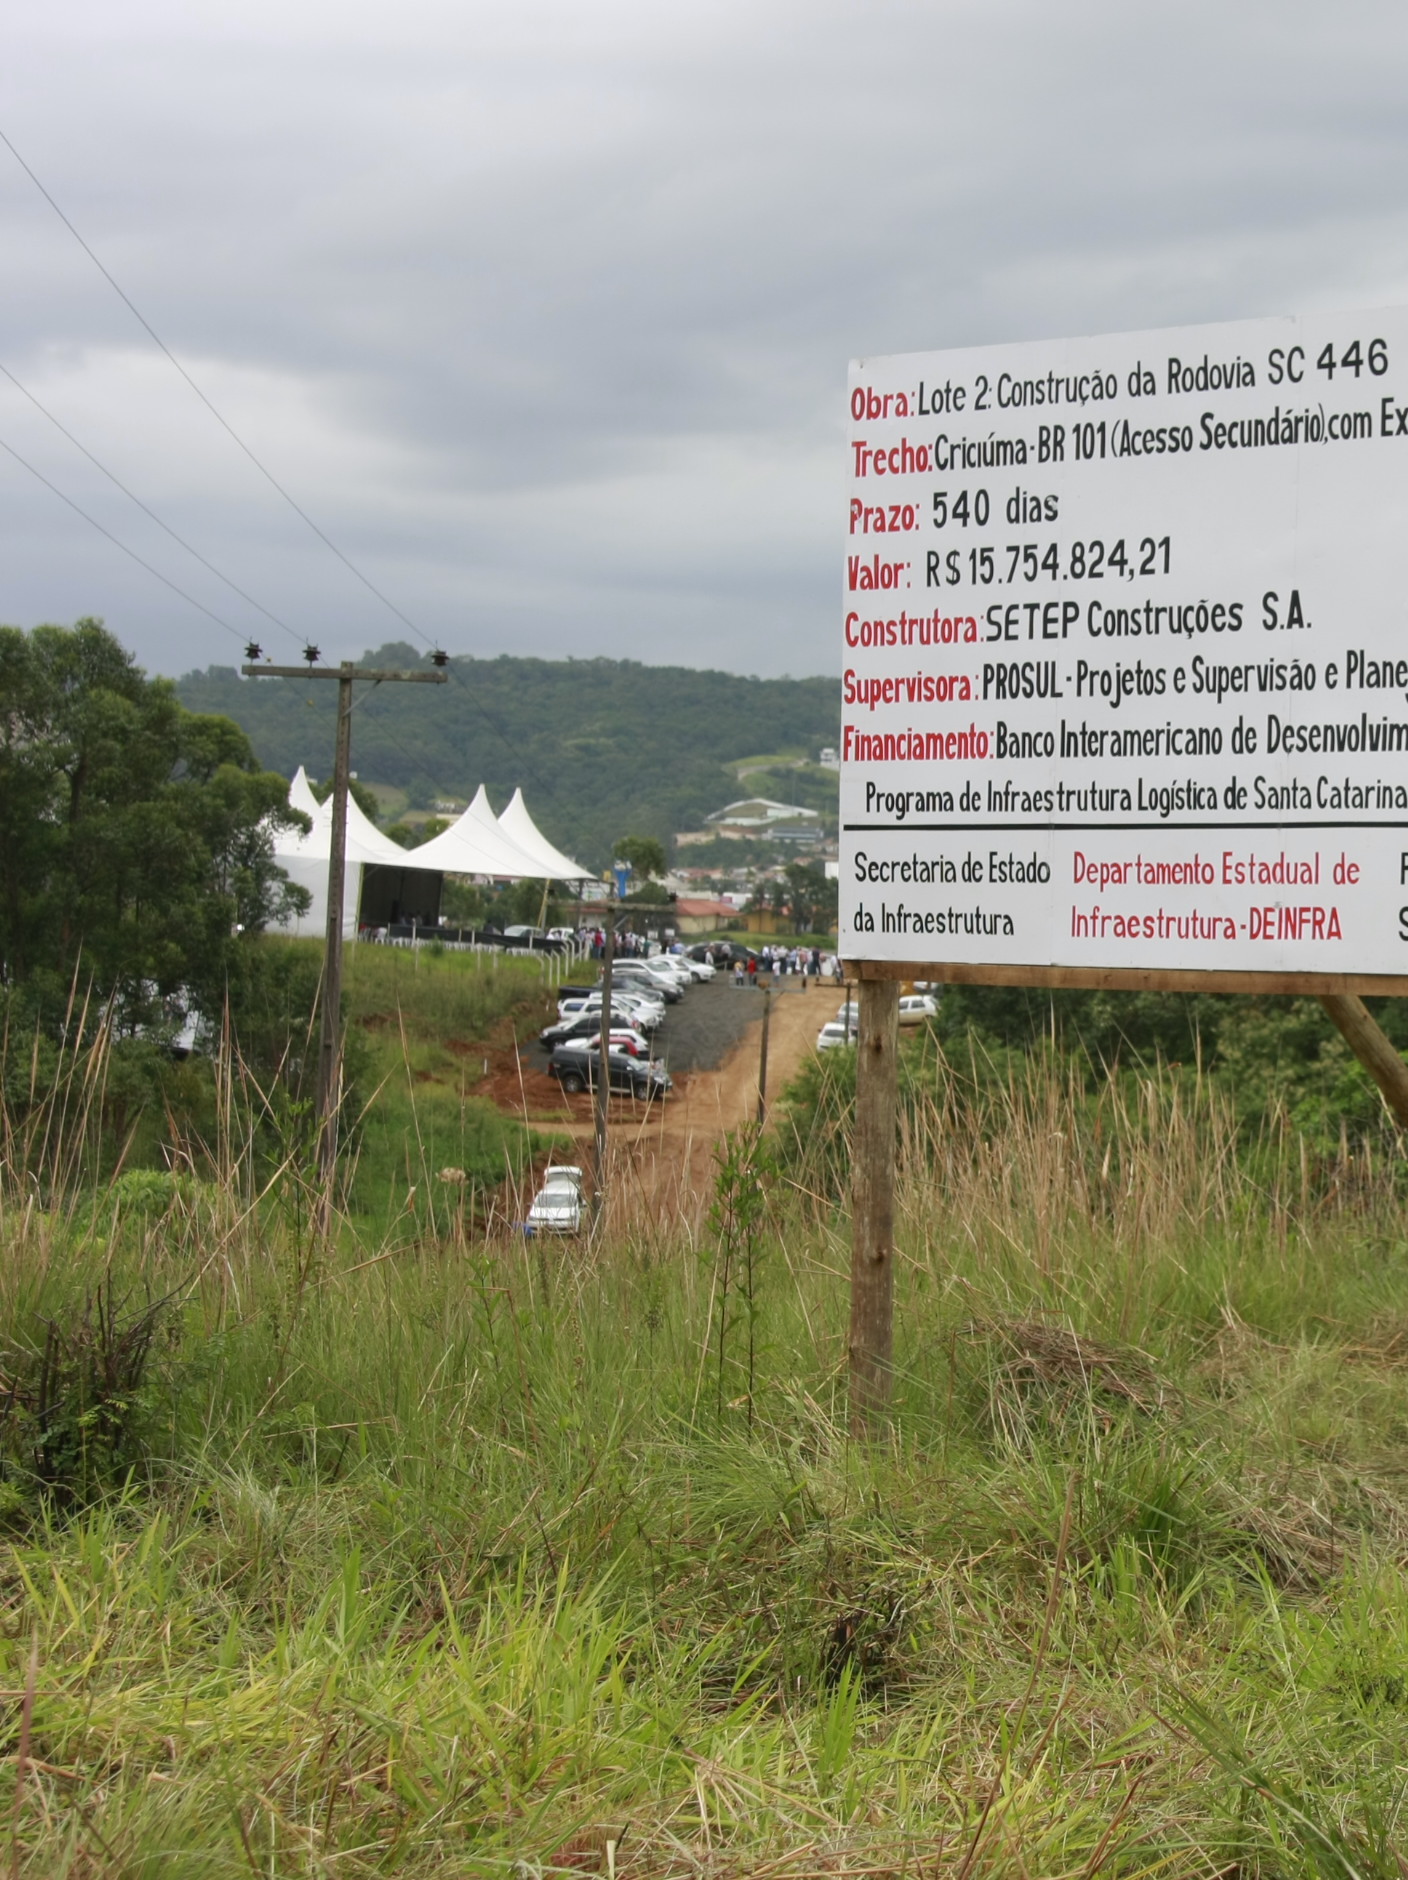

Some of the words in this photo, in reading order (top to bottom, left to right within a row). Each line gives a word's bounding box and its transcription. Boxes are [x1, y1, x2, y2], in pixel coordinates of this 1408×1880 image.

[851, 386, 915, 421] Obra:
[918, 379, 966, 416] Lote
[999, 369, 1118, 408] Construção
[1128, 361, 1156, 397] da
[1167, 355, 1255, 394] Rodovia
[1268, 346, 1305, 385] SC
[1316, 338, 1389, 380] 446
[849, 498, 920, 534] Prazo:
[933, 489, 989, 528] 540
[1006, 486, 1059, 524] dias
[848, 555, 911, 591] Valor:
[986, 601, 1079, 642] SETEP
[1087, 599, 1243, 639] Construções
[1262, 590, 1312, 630] S.A.
[1173, 669, 1185, 693] e
[1191, 654, 1316, 704] Supervisão
[1325, 662, 1338, 689] e
[996, 721, 1054, 759] Banco
[1060, 719, 1222, 758] Interamericano
[1231, 715, 1257, 754] de
[866, 782, 954, 820] Programa
[959, 780, 981, 812] de
[987, 780, 1131, 812] Infraestrutura
[1138, 777, 1217, 818] Logística
[1223, 776, 1247, 810] de
[1254, 776, 1312, 809] Santa
[1317, 775, 1407, 809] Catarina
[854, 851, 957, 883] Secretaria
[961, 851, 983, 883] de
[989, 851, 1050, 883] Estado
[1073, 851, 1214, 892] Departamento
[1222, 851, 1319, 885] Estadual
[1333, 852, 1360, 884] de
[853, 903, 874, 933] da
[881, 903, 1014, 936] Infraestrutura
